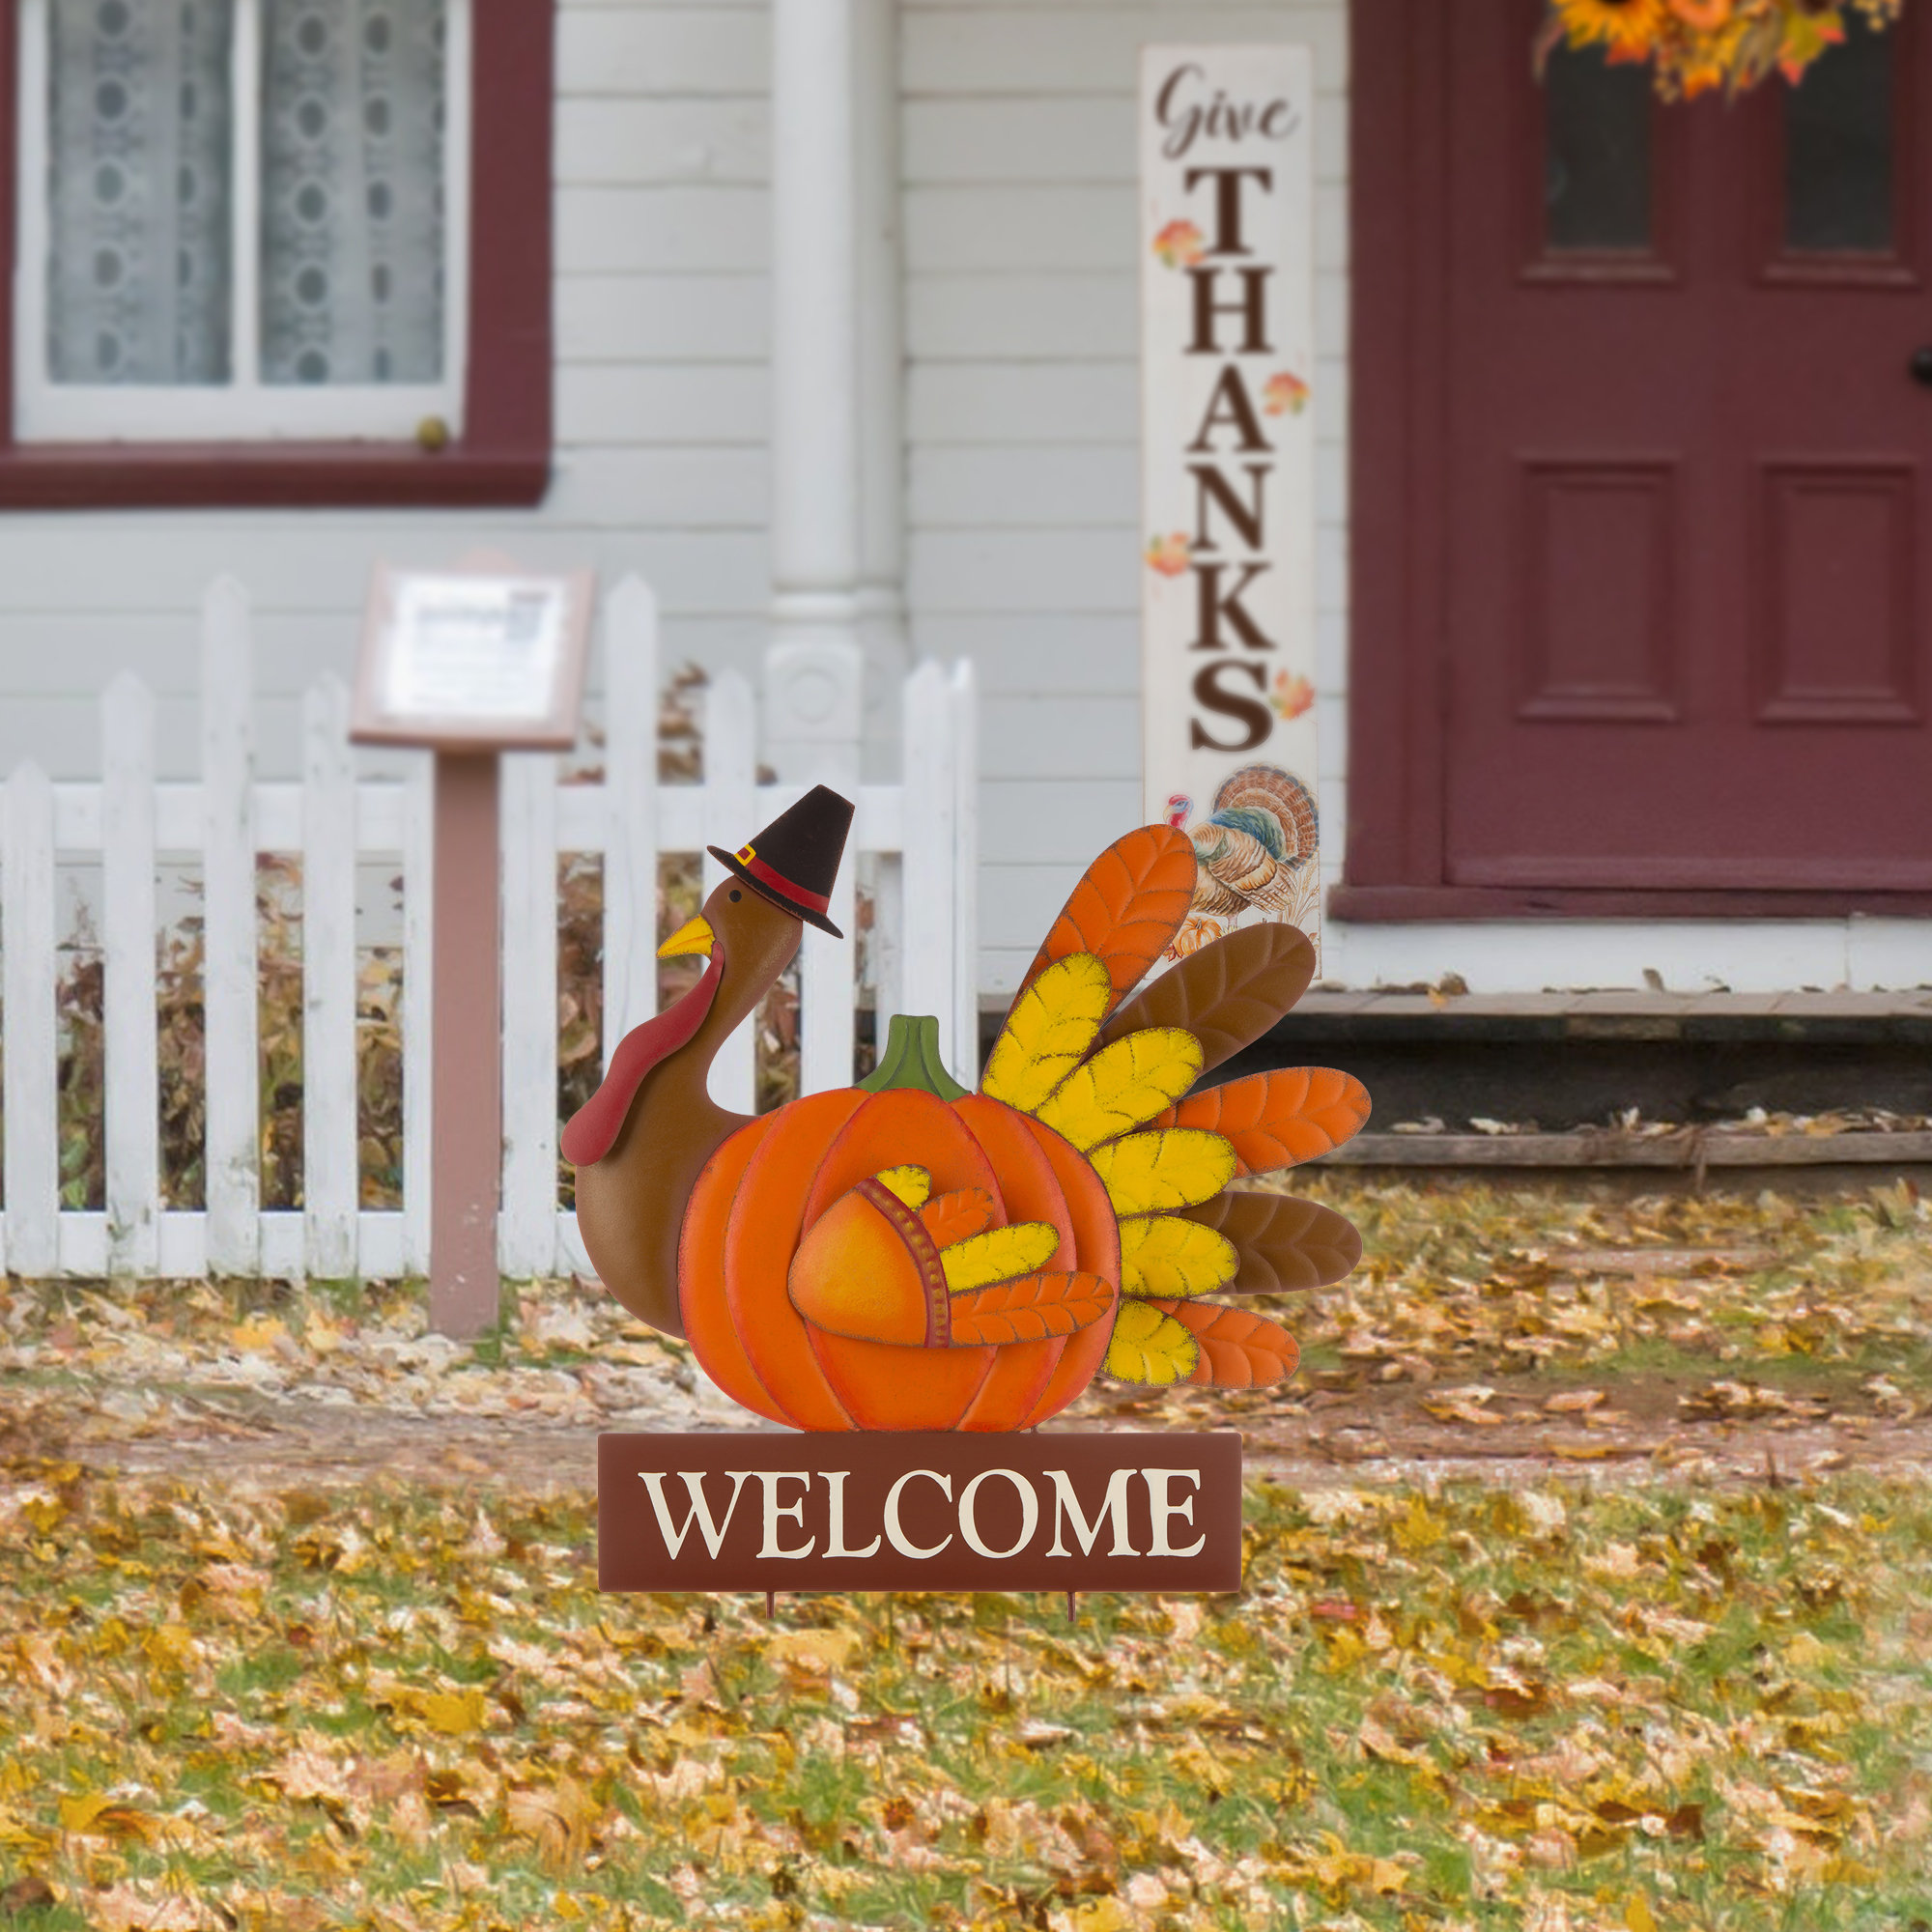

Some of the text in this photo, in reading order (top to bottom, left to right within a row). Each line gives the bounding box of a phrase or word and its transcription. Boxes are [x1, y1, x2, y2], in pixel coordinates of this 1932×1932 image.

[1154, 63, 1299, 160] Give
[1183, 167, 1276, 753] THANKS
[638, 1467, 1207, 1561] WELCOME
